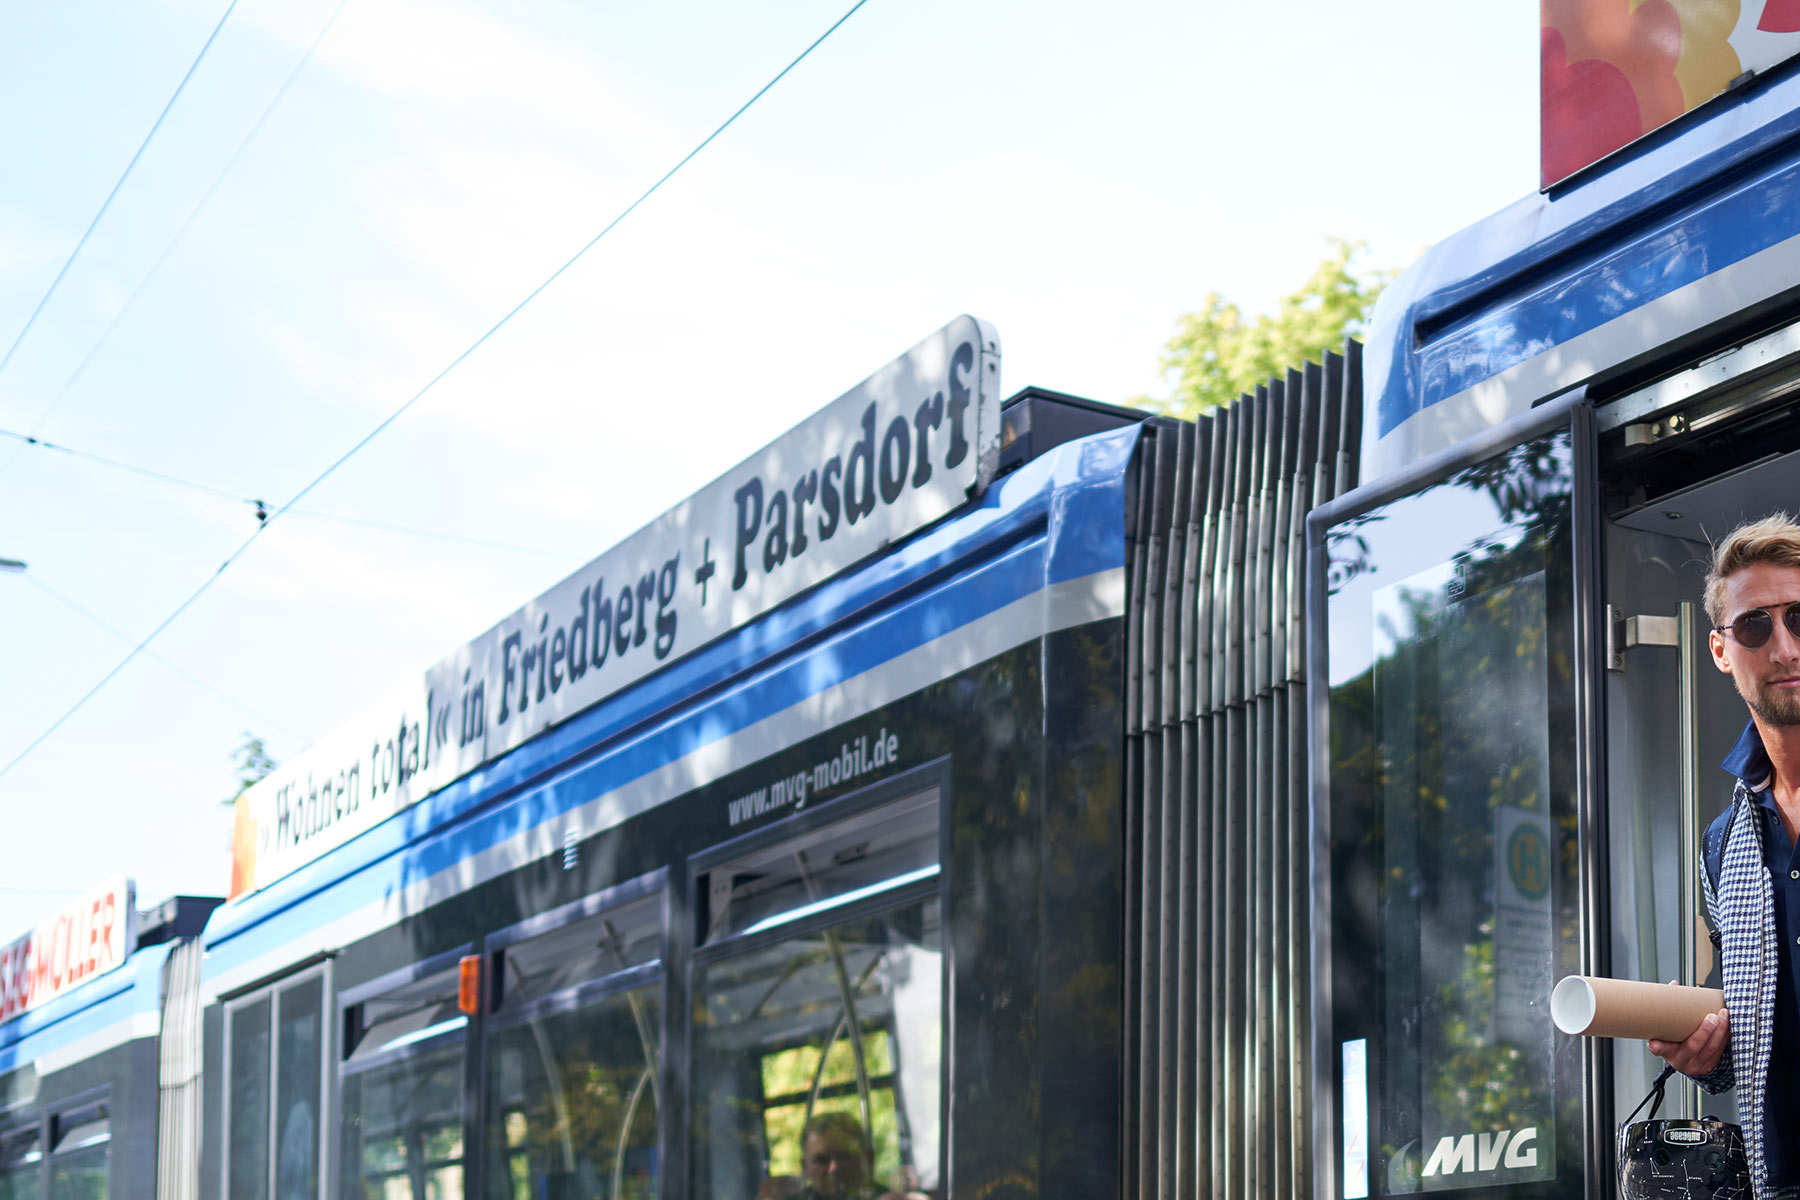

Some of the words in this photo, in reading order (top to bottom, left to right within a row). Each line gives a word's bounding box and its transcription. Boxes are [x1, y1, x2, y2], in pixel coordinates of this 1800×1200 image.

[460, 666, 485, 749] in
[497, 549, 680, 726] Friedberg
[695, 536, 716, 607] +
[731, 340, 974, 591] Parsdorf
[728, 727, 898, 827] www.mvg-mobil.de
[1421, 1127, 1537, 1177] MVG
